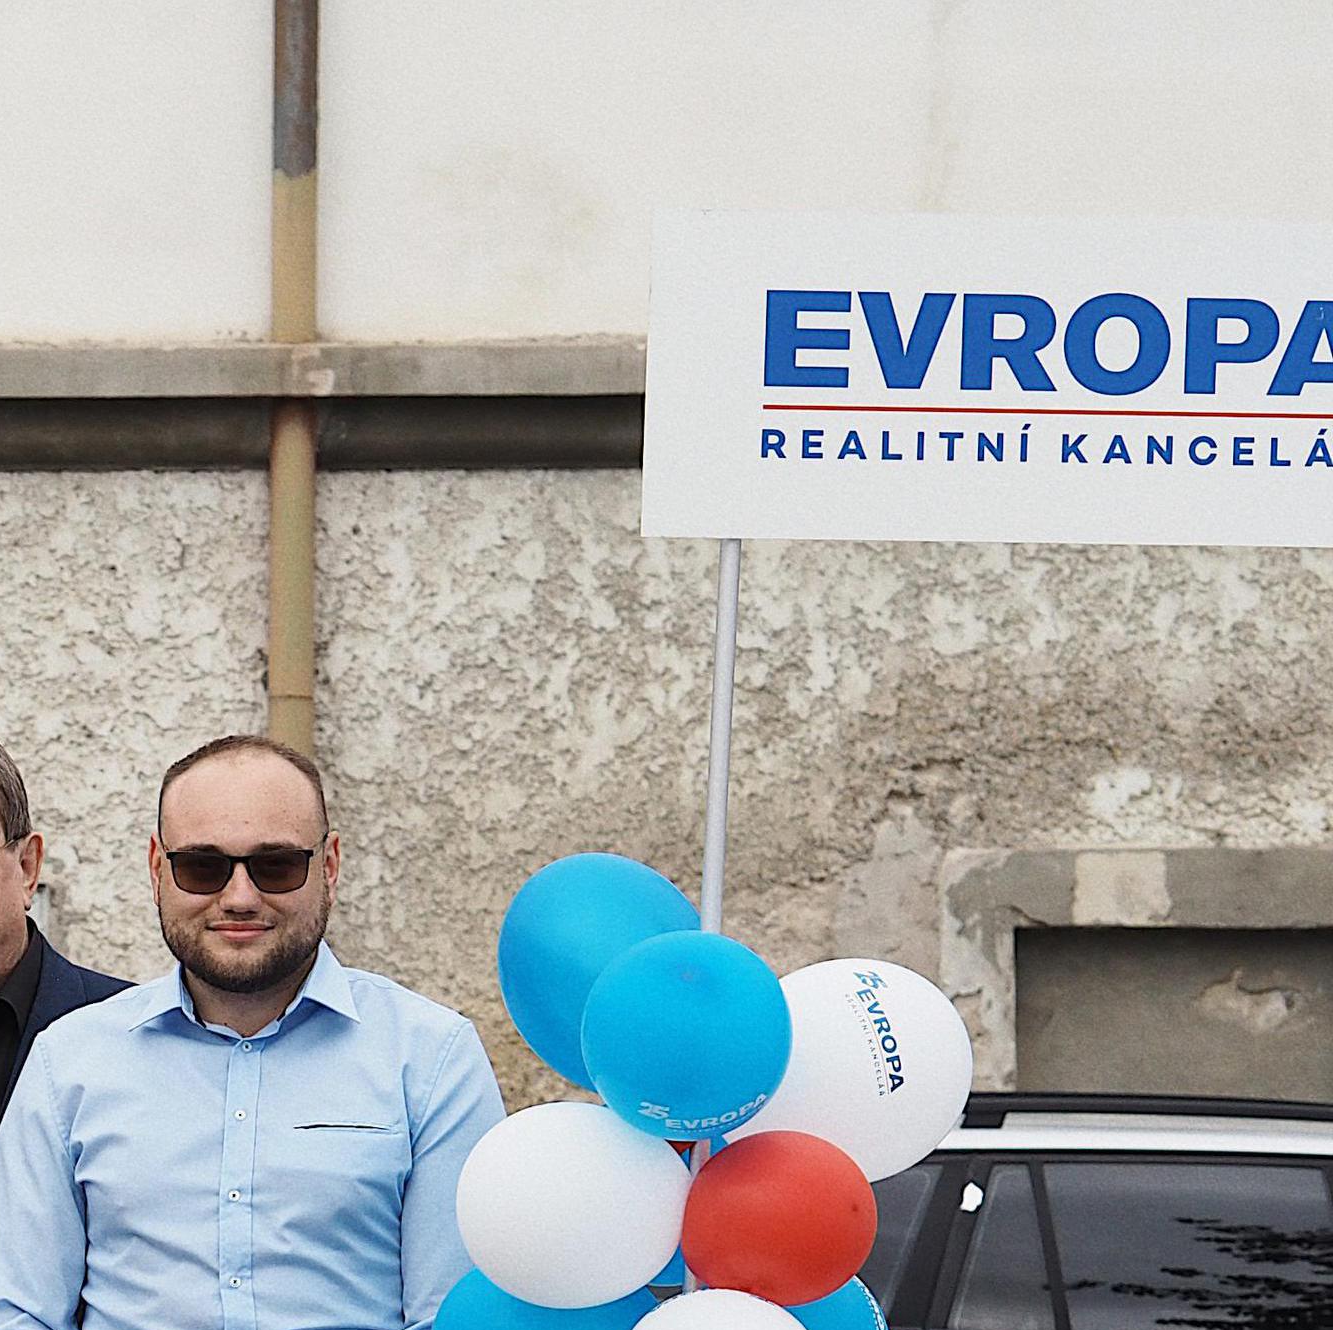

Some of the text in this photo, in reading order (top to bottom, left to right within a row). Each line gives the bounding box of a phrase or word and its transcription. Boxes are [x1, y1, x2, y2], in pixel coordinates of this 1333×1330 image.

[764, 290, 1333, 397] EVROPA
[760, 423, 1333, 467] REALITNÍ KANCELÁ
[856, 988, 905, 1093] EVROPA
[664, 1093, 767, 1129] EVROPA
